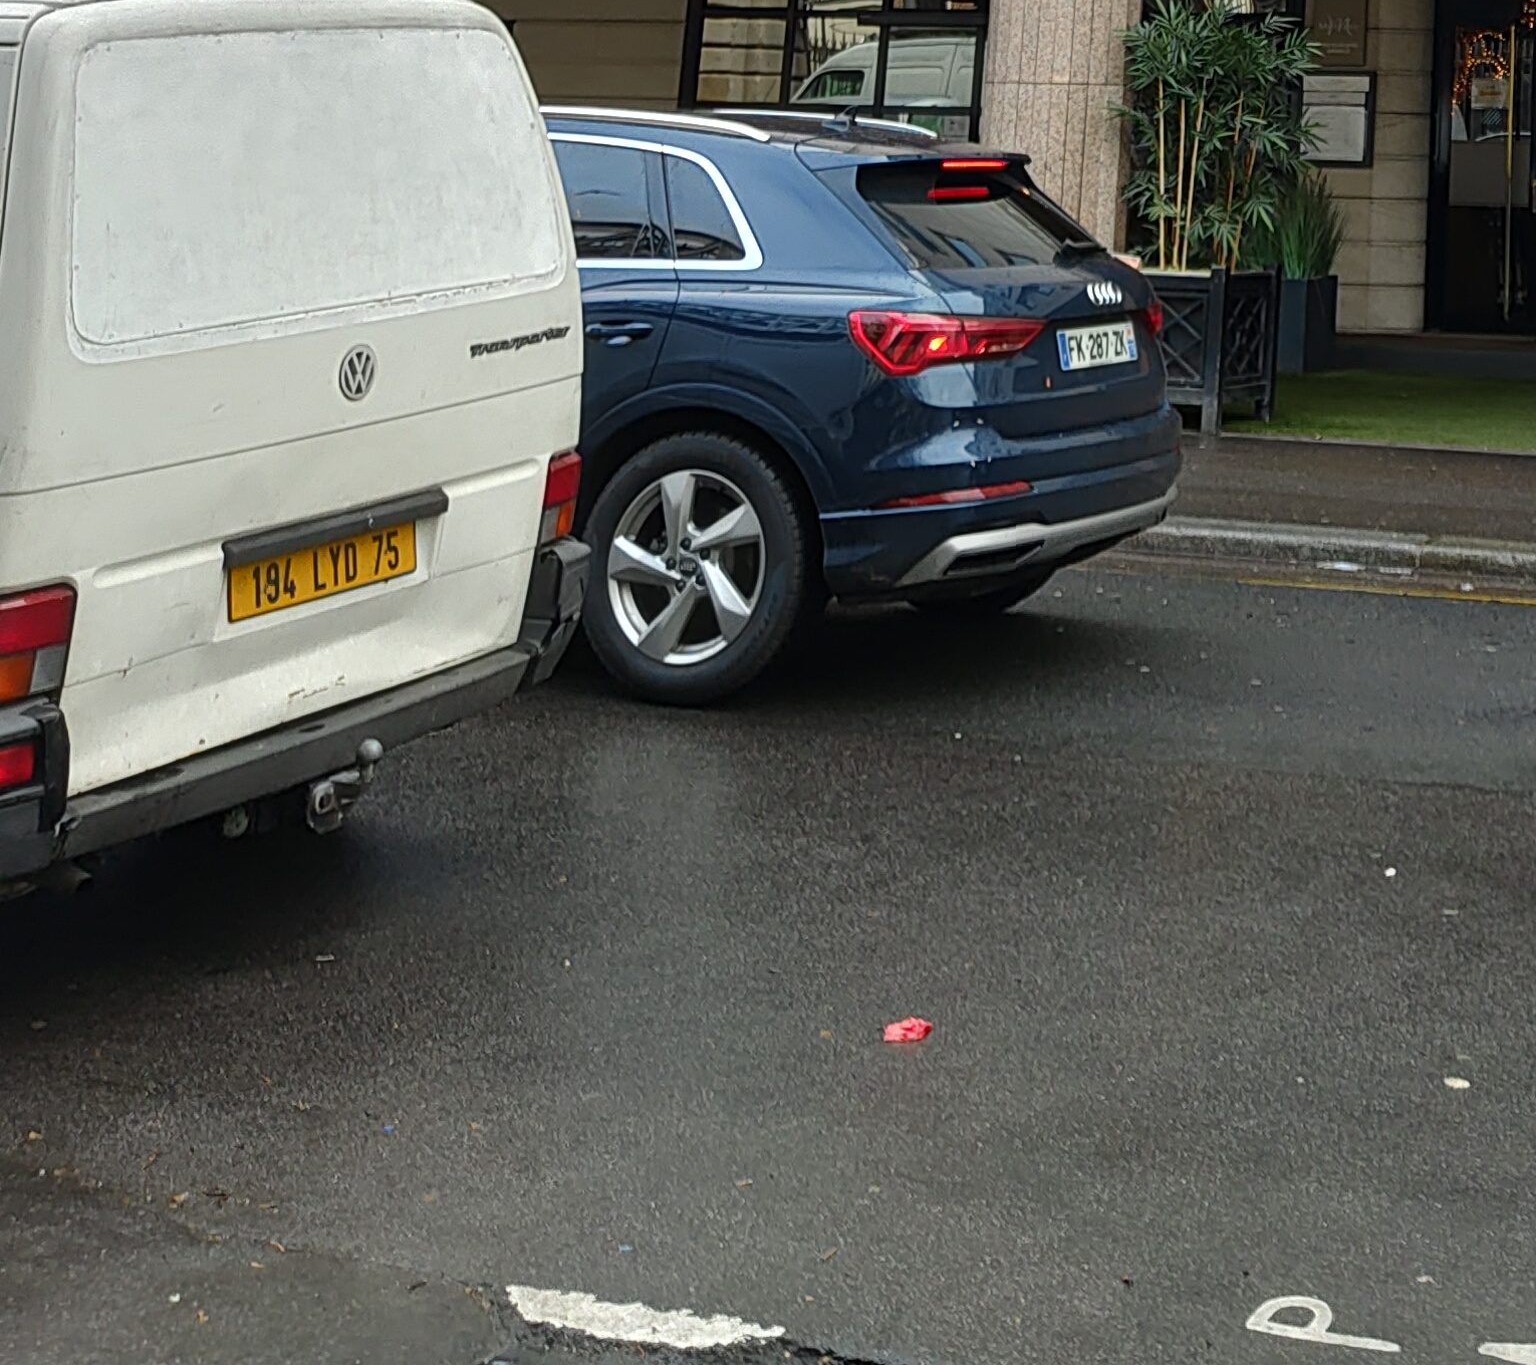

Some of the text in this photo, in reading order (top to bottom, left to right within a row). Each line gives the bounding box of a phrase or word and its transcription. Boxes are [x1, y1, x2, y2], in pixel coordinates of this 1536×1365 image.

[252, 529, 399, 609] 194 LYD 75
